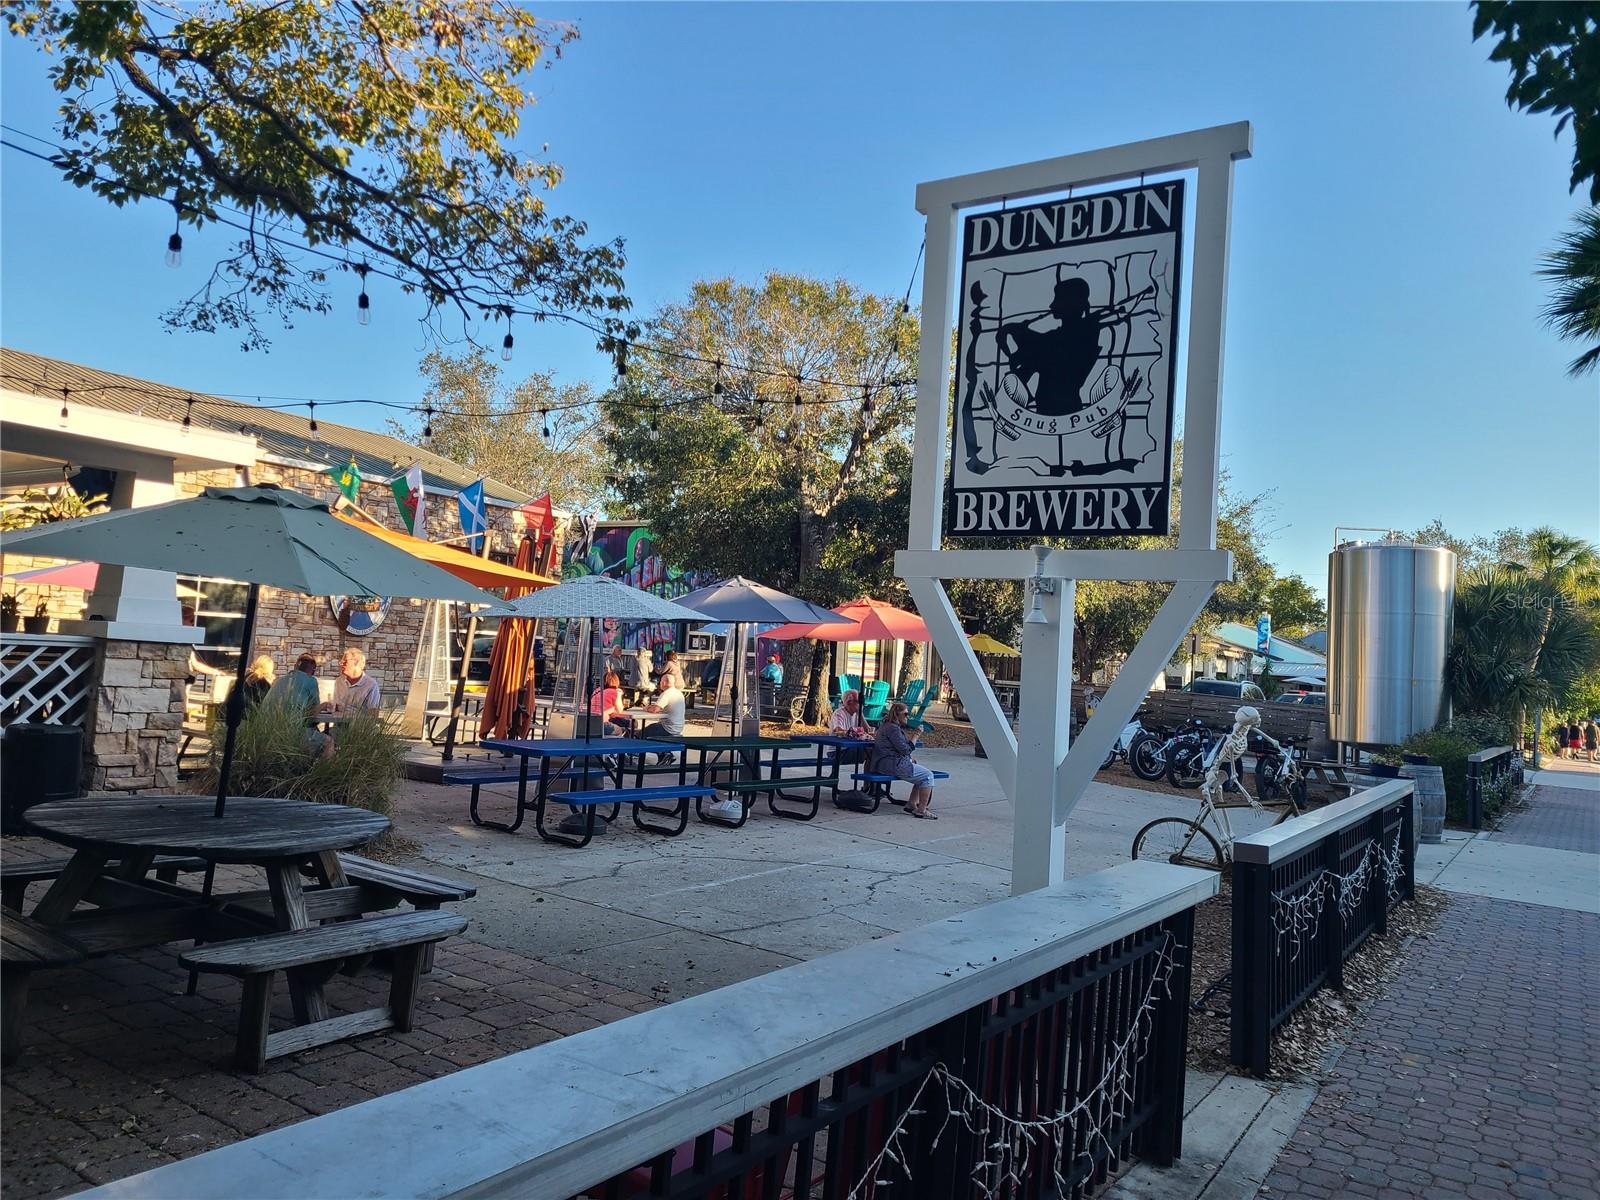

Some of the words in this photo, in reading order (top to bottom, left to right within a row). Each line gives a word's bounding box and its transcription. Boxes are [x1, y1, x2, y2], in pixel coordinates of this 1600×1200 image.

[969, 185, 1176, 256] DUNEDIN
[1010, 408, 1057, 433] Snug
[1070, 406, 1108, 428] Pub
[953, 487, 1162, 531] BREWERY
